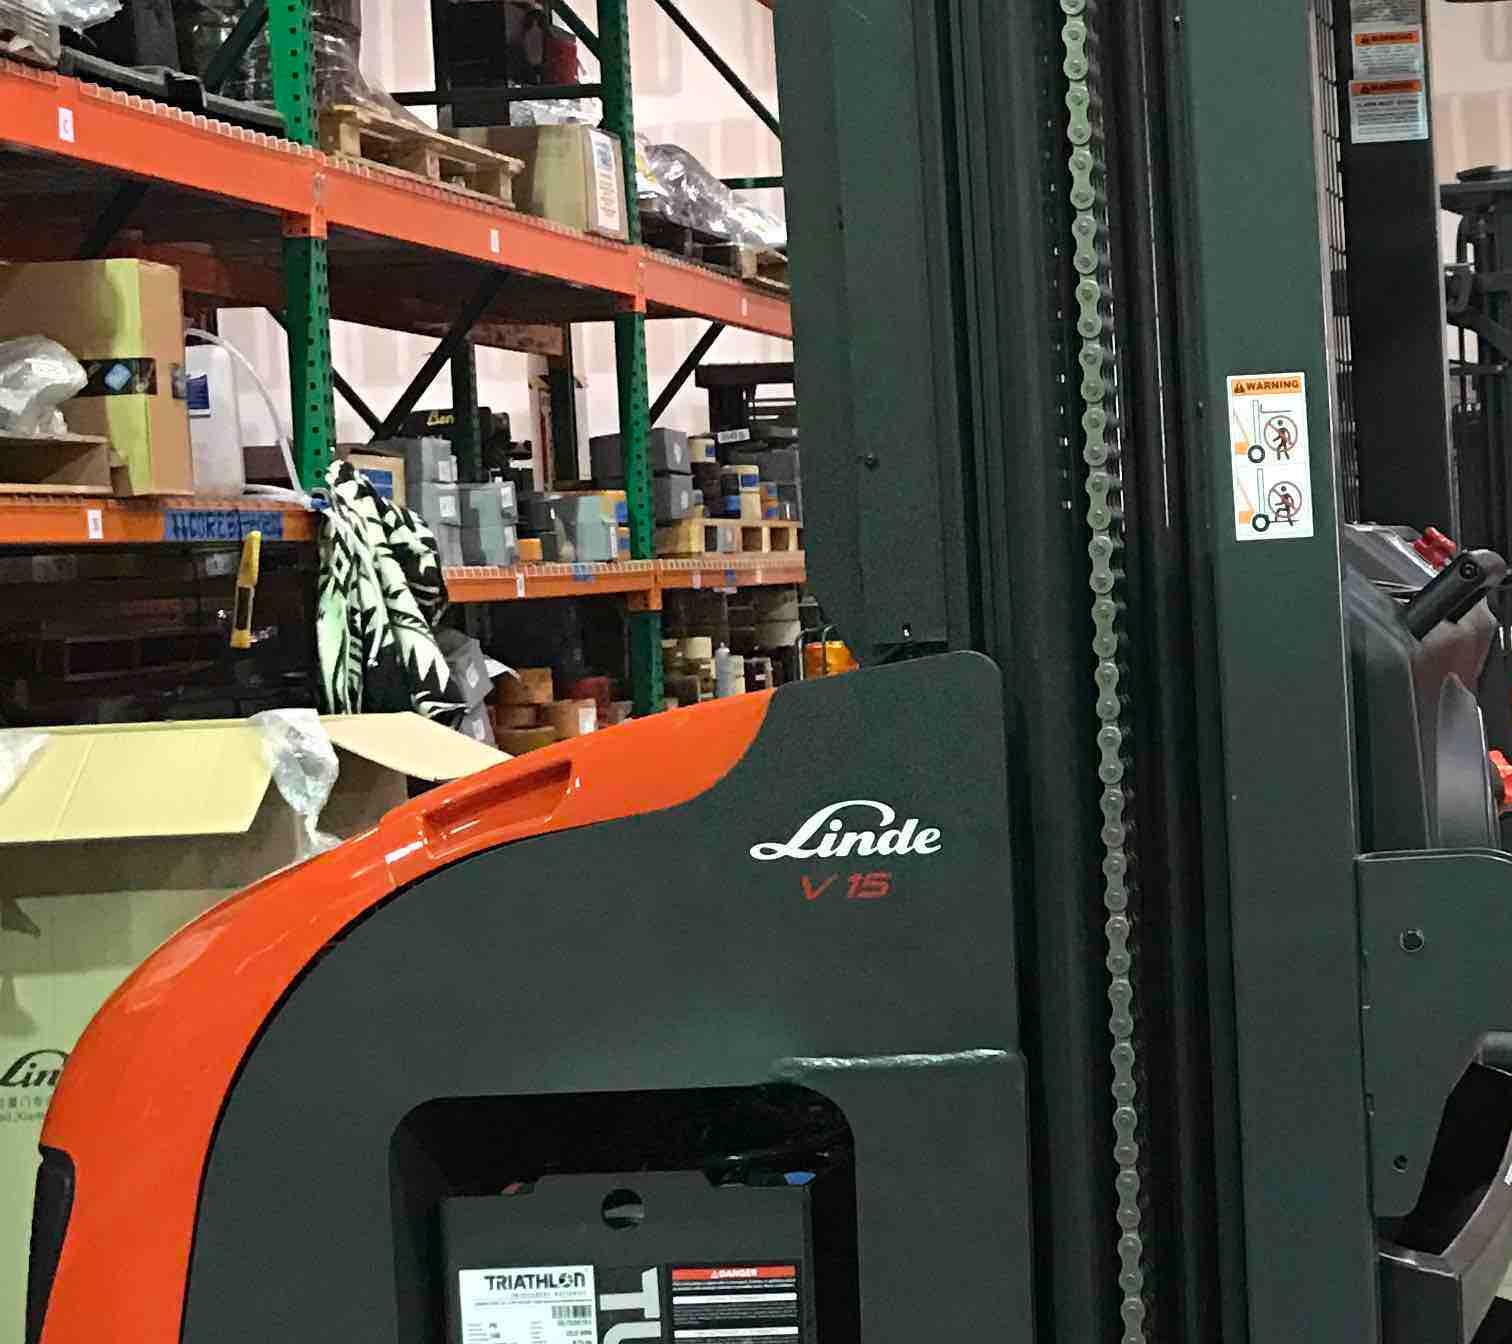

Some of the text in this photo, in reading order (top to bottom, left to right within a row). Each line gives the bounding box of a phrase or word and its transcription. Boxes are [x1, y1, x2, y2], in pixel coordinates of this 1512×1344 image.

[1246, 379, 1300, 391] WARNING
[749, 799, 942, 860] Linde
[0, 1049, 70, 1088] Lin
